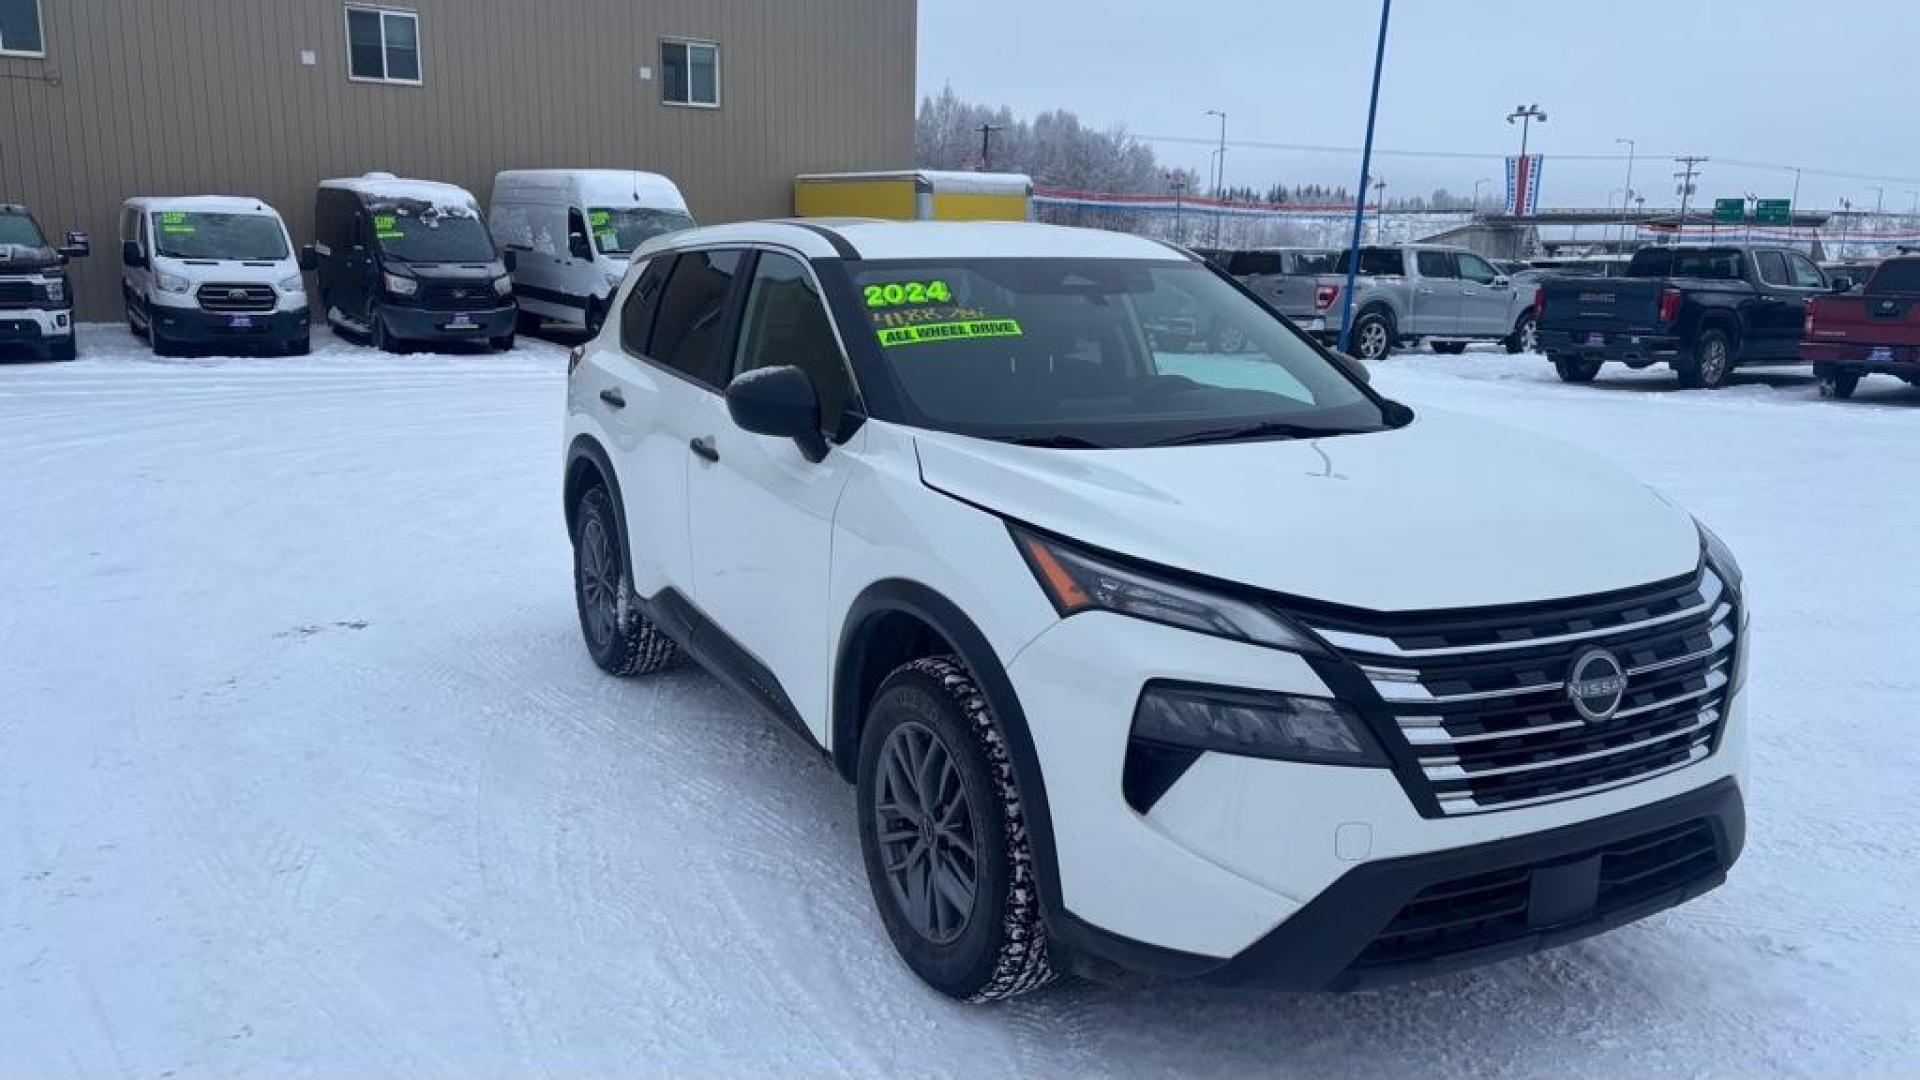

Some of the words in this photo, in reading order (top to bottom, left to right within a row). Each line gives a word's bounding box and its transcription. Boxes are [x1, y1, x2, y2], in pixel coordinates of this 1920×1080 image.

[864, 281, 951, 306] 2024
[886, 329, 914, 342] ALL
[916, 324, 967, 338] WHEEL
[970, 321, 1015, 335] DRIVE
